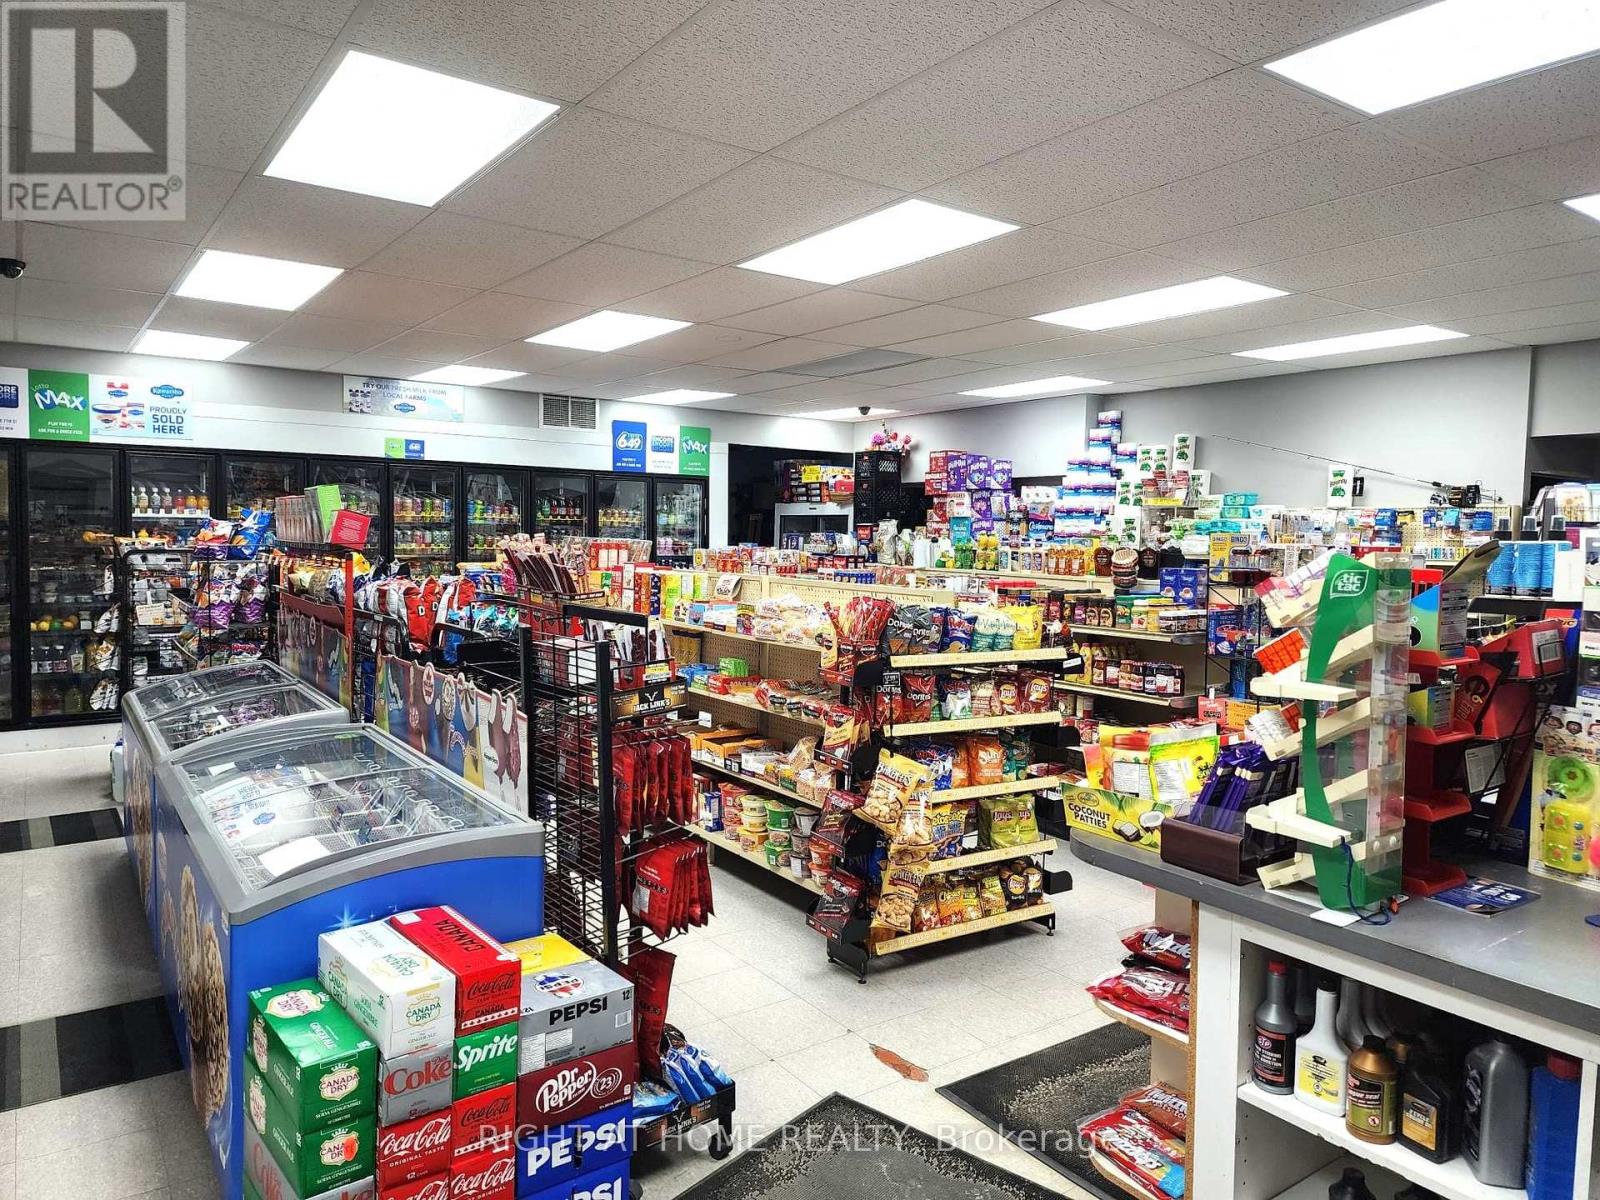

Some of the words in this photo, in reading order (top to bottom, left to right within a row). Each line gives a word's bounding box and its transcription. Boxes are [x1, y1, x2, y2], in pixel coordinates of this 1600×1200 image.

[34, 389, 85, 411] MAX
[383, 391, 403, 400] LOCAL
[405, 393, 428, 401] FARMS
[150, 406, 187, 415] PROUDLY
[152, 414, 184, 425] SOLD
[153, 424, 184, 435] HERE
[682, 439, 708, 455] MAX
[1341, 572, 1363, 584] tic
[1337, 582, 1360, 592] tac
[1068, 802, 1111, 821] COCONUT
[1074, 811, 1107, 829] PATTIES
[434, 918, 487, 953] CANADA
[467, 971, 516, 1000] Coca-Cola
[540, 978, 579, 990] PEPSI
[622, 990, 630, 1001] 12
[405, 1002, 441, 1019] CANADA
[415, 1012, 432, 1022] DRY
[549, 996, 608, 1026] PEPSI
[455, 1034, 518, 1073] Sprite
[320, 1074, 359, 1090] CANADA
[384, 1059, 452, 1096] Coke
[557, 1066, 579, 1087] Dr
[600, 1077, 613, 1091] 23
[330, 1084, 348, 1095] DRY
[543, 1070, 593, 1114] Pepper
[461, 1097, 512, 1127] Coca-Cola
[380, 1114, 452, 1156] Coca-Cola
[527, 1117, 626, 1177] PEPSI
[389, 1154, 422, 1168] ORIGINAL
[424, 1146, 445, 1156] TASTE
[450, 1155, 515, 1195] Coca-Cola
[478, 1185, 507, 1199] ORIGINAL
